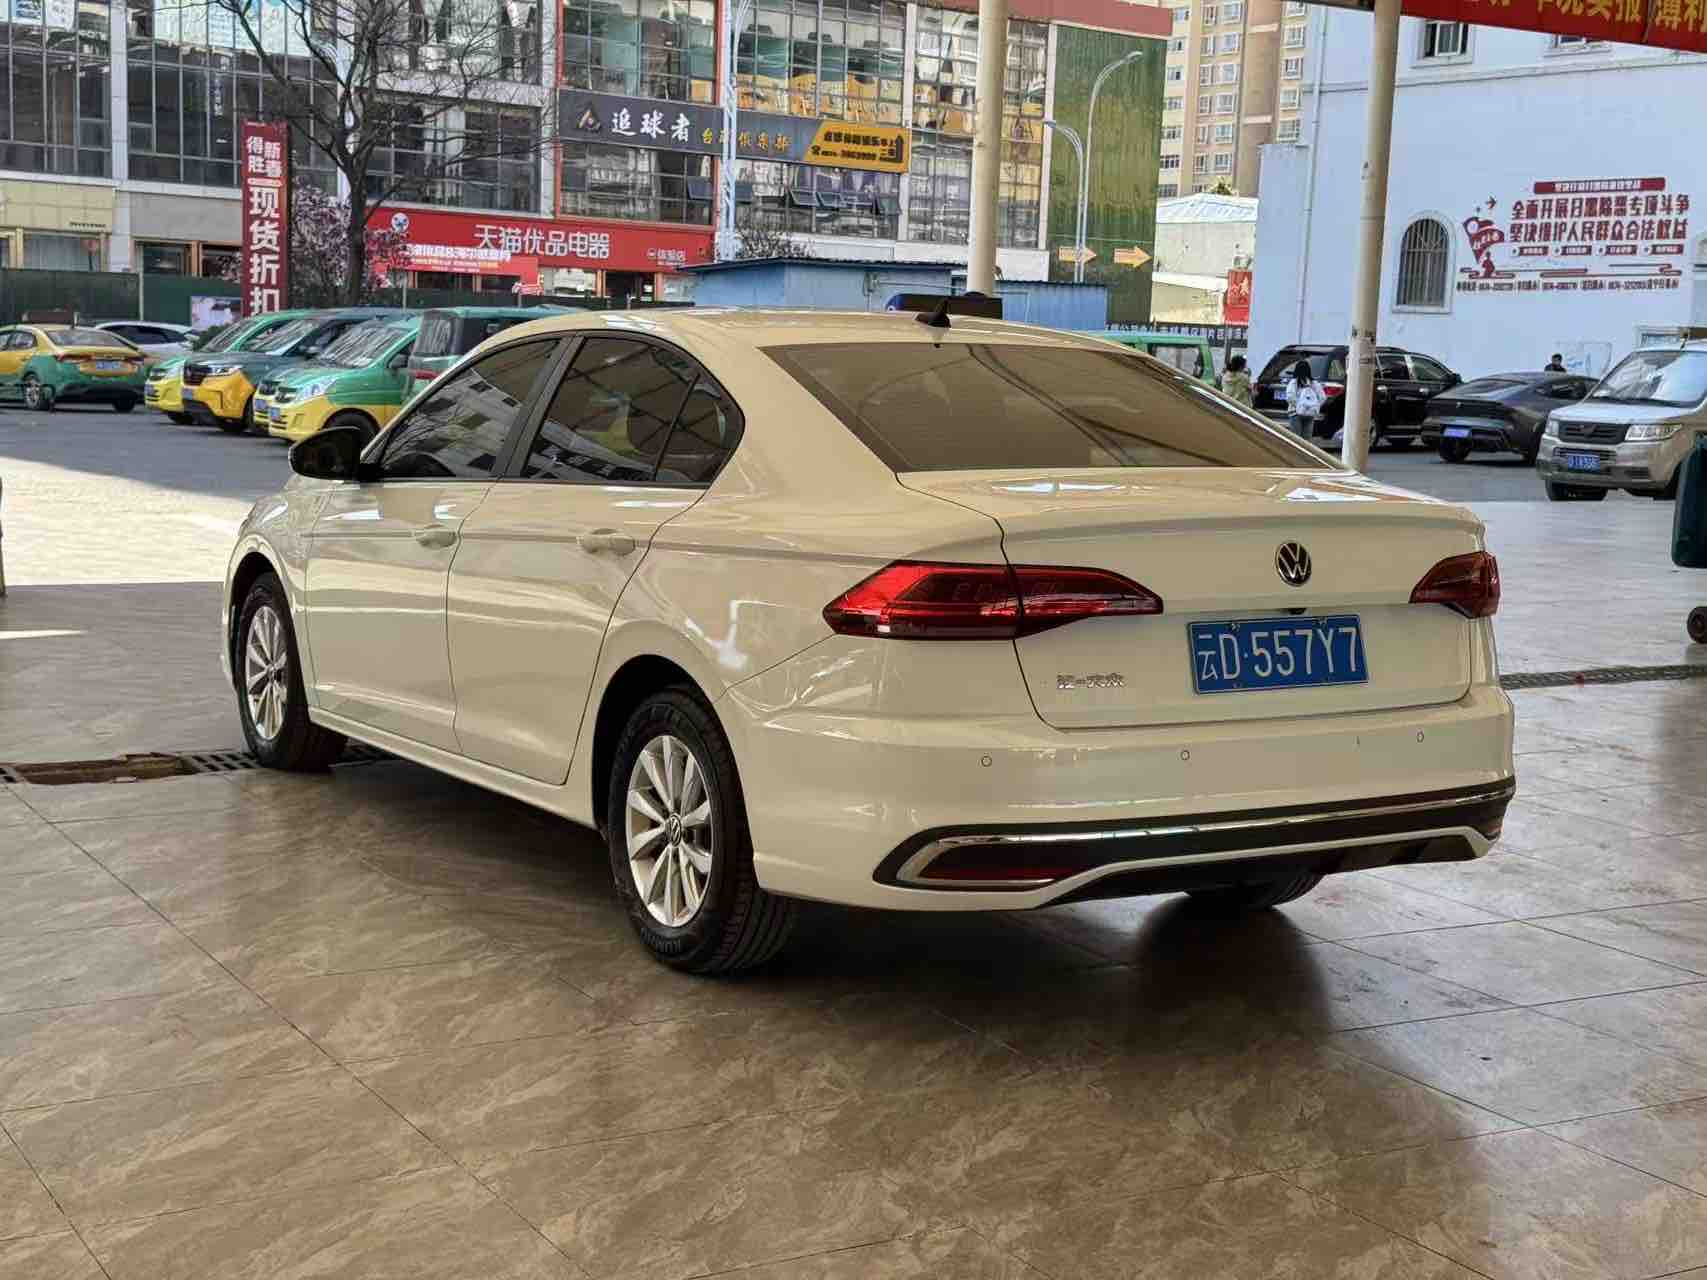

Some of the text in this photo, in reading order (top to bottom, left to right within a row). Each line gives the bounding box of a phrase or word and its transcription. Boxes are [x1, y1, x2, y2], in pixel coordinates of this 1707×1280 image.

[611, 107, 690, 143] 追球者
[249, 187, 281, 315] 现货折扣
[474, 224, 611, 259] 天猫优品电器
